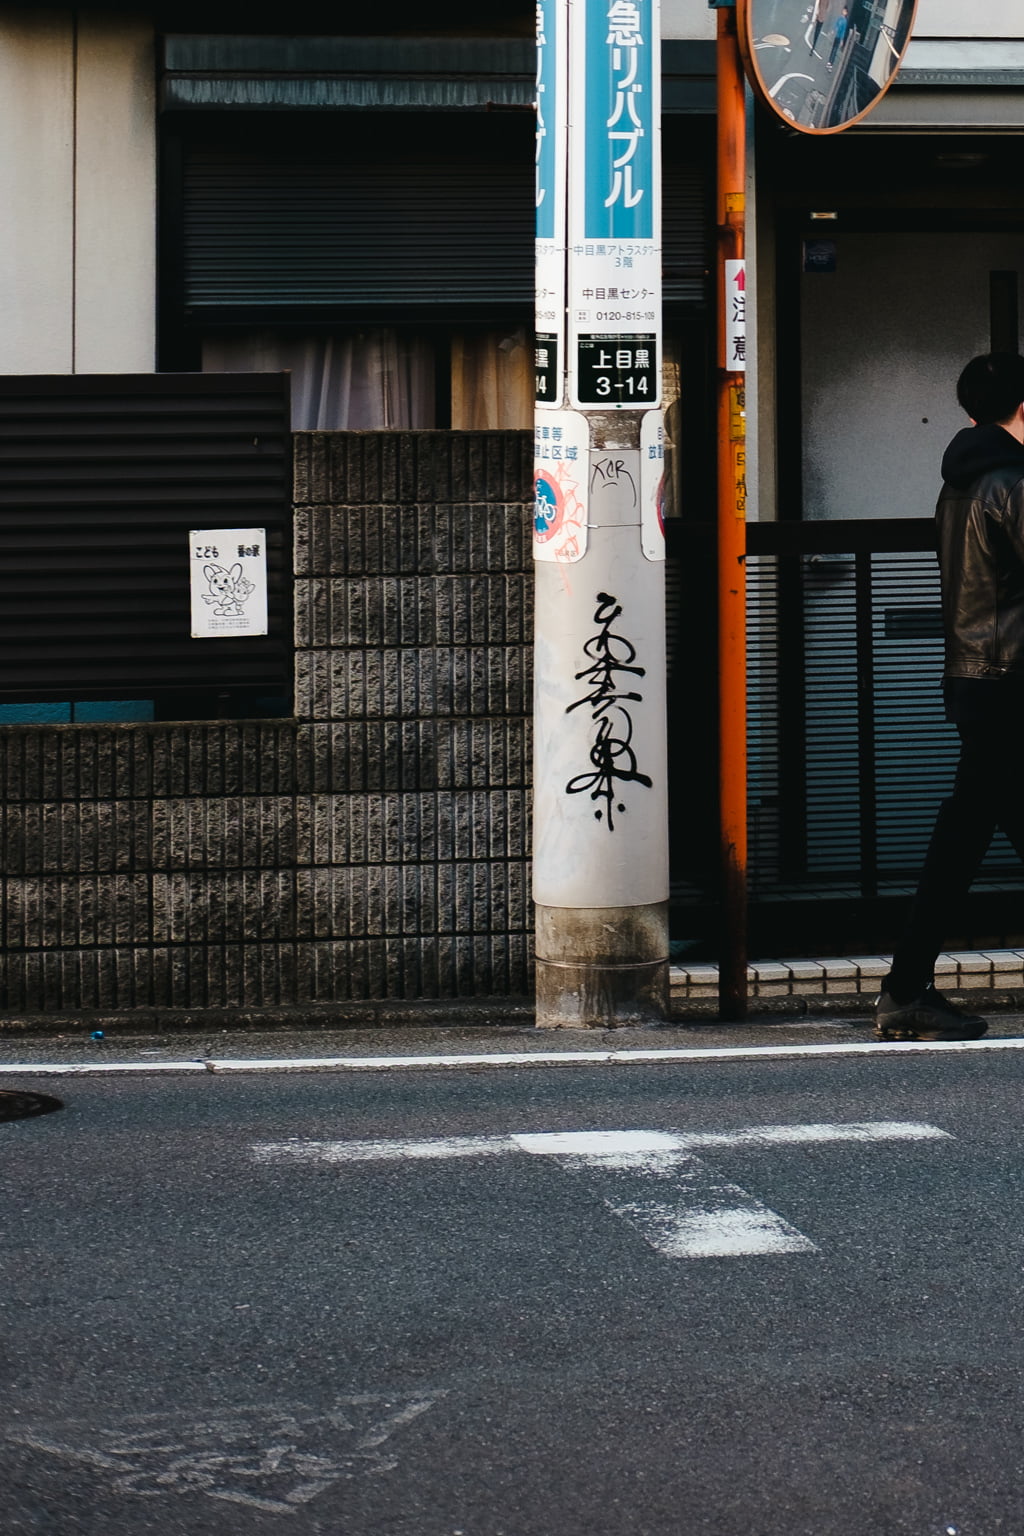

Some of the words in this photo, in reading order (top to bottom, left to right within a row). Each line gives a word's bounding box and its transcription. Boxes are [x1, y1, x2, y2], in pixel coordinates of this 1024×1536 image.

[573, 245, 662, 256] 中目黒アトラスタワー
[615, 257, 633, 268] 3階
[582, 287, 655, 300] 中目黒センター
[596, 311, 655, 321] 0120-815-109
[592, 349, 650, 369] 上目黒
[595, 376, 649, 395] 3-14
[195, 545, 219, 558] こども
